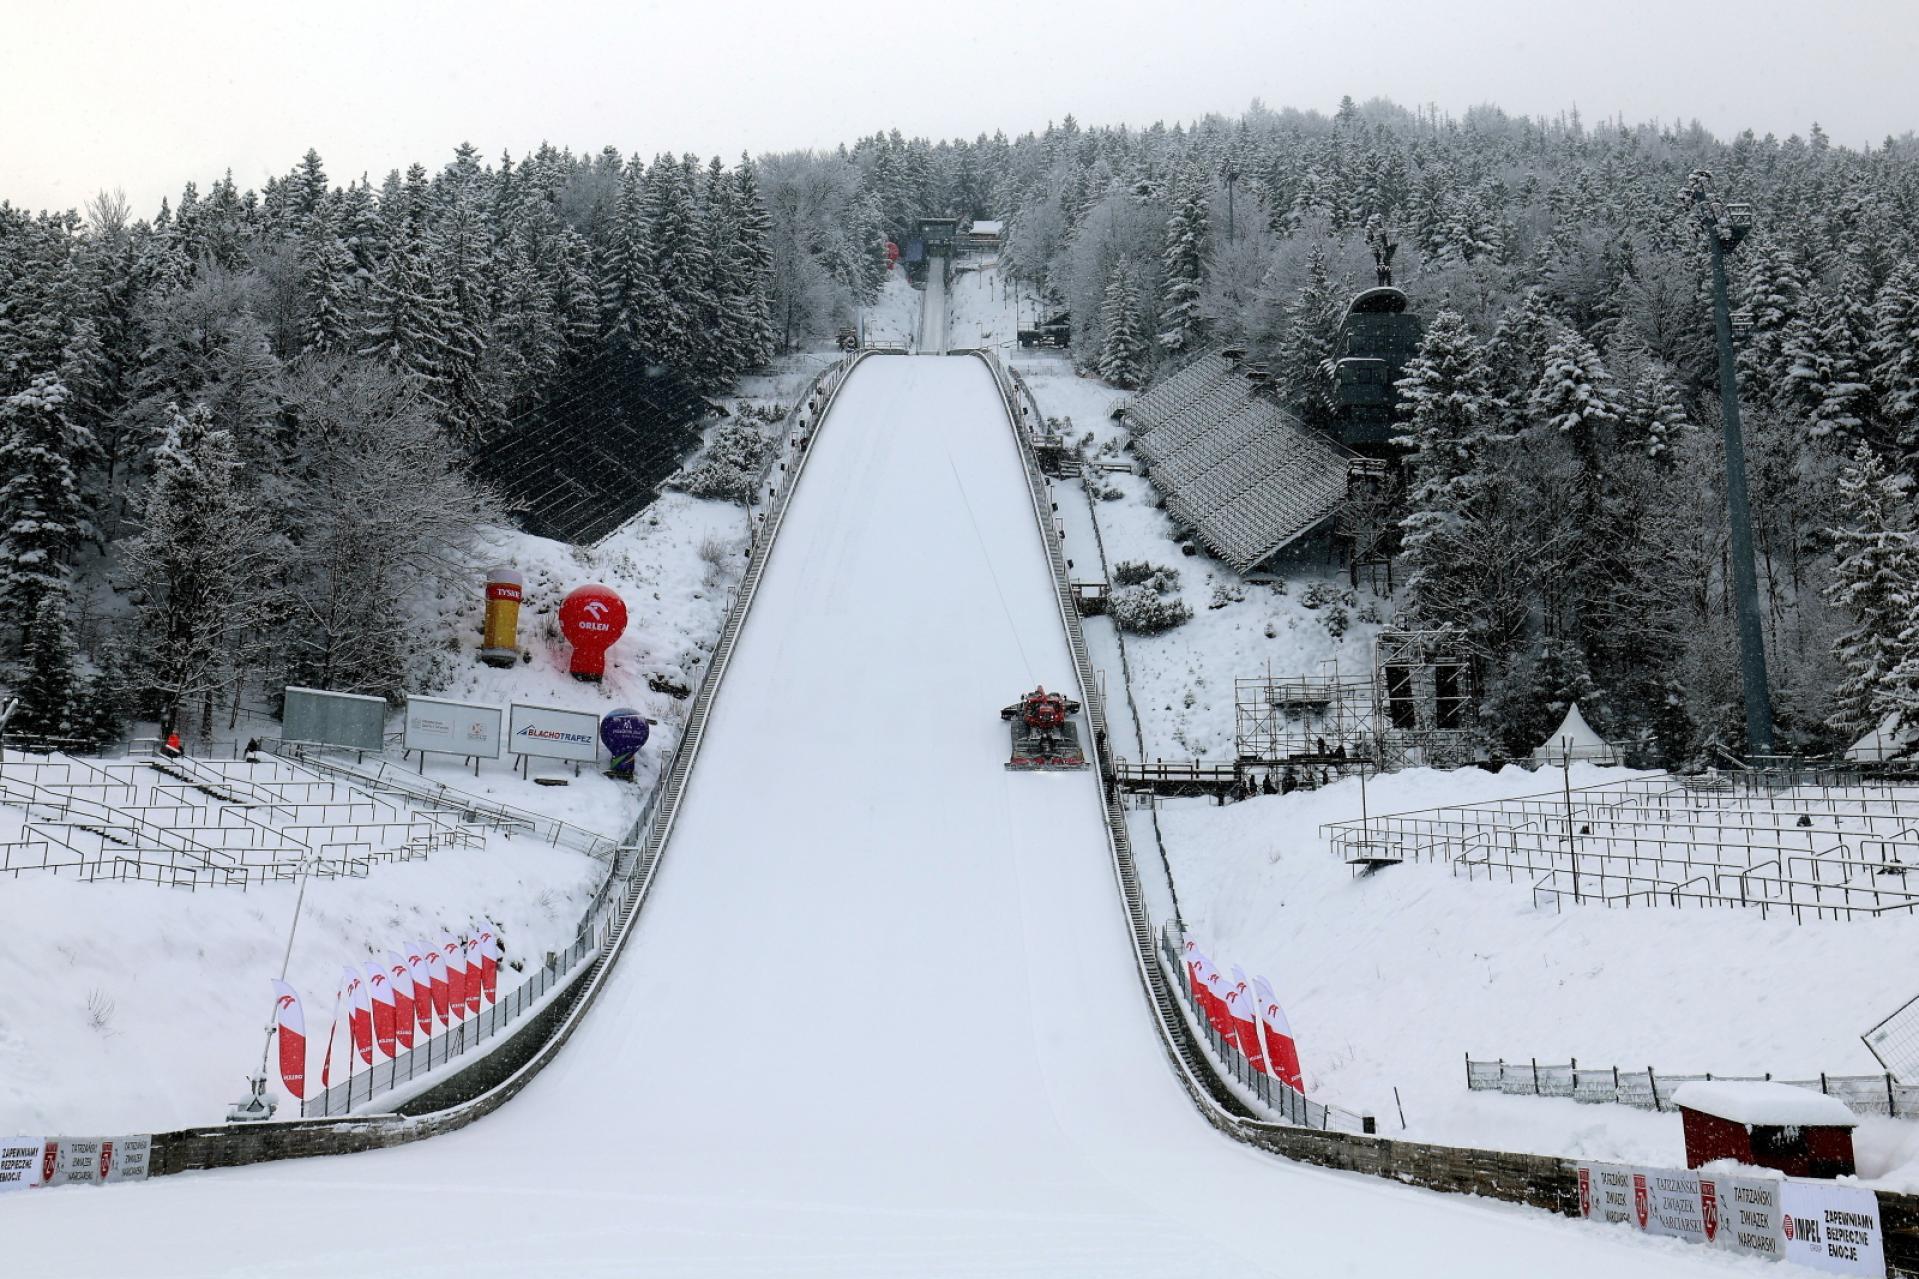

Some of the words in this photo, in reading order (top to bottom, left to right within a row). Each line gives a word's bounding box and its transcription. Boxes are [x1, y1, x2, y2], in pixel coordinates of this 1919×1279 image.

[579, 621, 609, 632] ORLEN
[528, 728, 592, 743] BLACHOTRAPEZ
[1734, 1186, 1773, 1207] TATRZAŃSKI
[1824, 1209, 1873, 1230] ZAPEWNIAMY
[1794, 1217, 1821, 1243] IMPEL
[1826, 1226, 1869, 1246] BEZPIECZNE
[1828, 1243, 1858, 1261] EMOCJE
